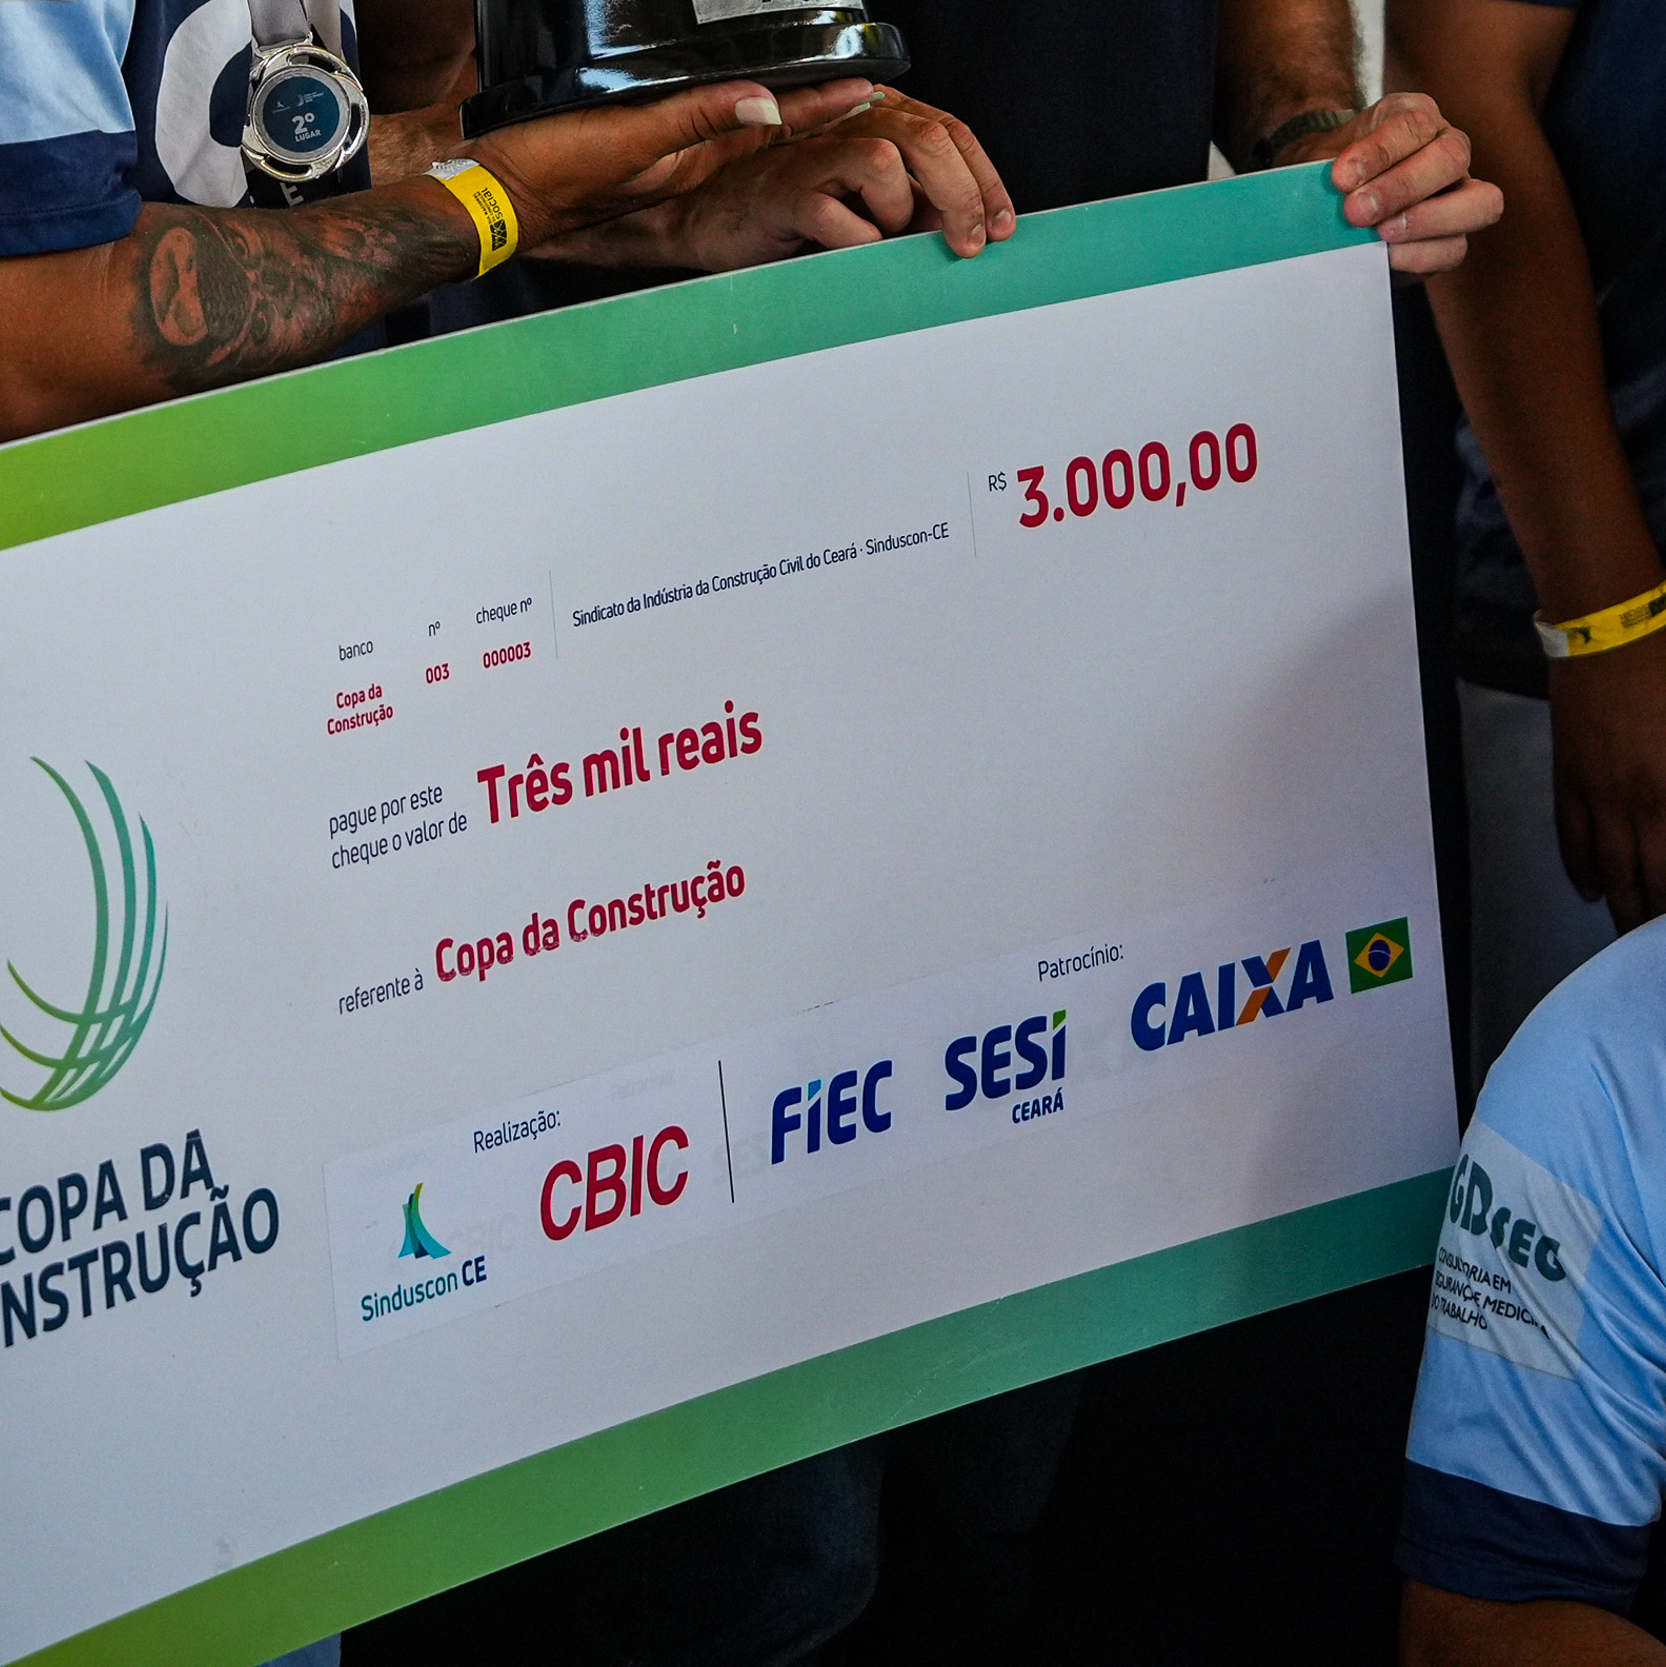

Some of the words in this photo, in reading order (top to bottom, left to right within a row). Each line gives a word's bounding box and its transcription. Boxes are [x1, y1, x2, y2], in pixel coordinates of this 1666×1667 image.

[292, 112, 315, 135] 2º
[294, 129, 321, 142] LUGAR
[988, 472, 1007, 492] R$
[1017, 422, 1258, 528] 3.000,00
[572, 602, 625, 627] Sindicato
[626, 597, 641, 613] da
[643, 584, 694, 609] Indústria
[695, 580, 710, 596] da
[712, 563, 777, 593] Construção
[779, 556, 805, 577] Civil
[806, 553, 822, 569] do
[823, 543, 858, 565] Ceará
[865, 522, 950, 556] Sinduscon-CE
[428, 621, 441, 637] nº
[476, 602, 517, 624] cheque
[520, 597, 532, 614] nº
[339, 640, 373, 661] banco
[483, 641, 531, 668] 000003
[426, 663, 450, 684] 003
[336, 692, 366, 709] Copa
[368, 683, 383, 700] da
[327, 704, 393, 735] Construção
[477, 753, 573, 824] Três
[583, 727, 650, 797] mil
[658, 699, 763, 777] reais
[329, 804, 377, 838] pague
[381, 798, 407, 825] por
[409, 785, 443, 811] este
[332, 836, 389, 869] cheque
[392, 833, 402, 852] o
[405, 819, 444, 847] valor
[448, 811, 468, 834] de
[435, 931, 514, 983] Copa
[522, 912, 560, 956] da
[567, 860, 746, 943] Construção
[1036, 942, 1124, 982] Patrocínio:
[339, 978, 410, 1015] referente
[414, 968, 424, 991] à
[1130, 939, 1334, 1052] CAIXA
[1011, 1087, 1065, 1124] CEARÁ
[473, 1110, 561, 1153] Realização:
[140, 1128, 215, 1211] DA
[539, 1125, 690, 1241] CBIC
[361, 1269, 458, 1322] Sinduscon
[461, 1255, 488, 1287] CE
[1493, 1275, 1511, 1294] EM
